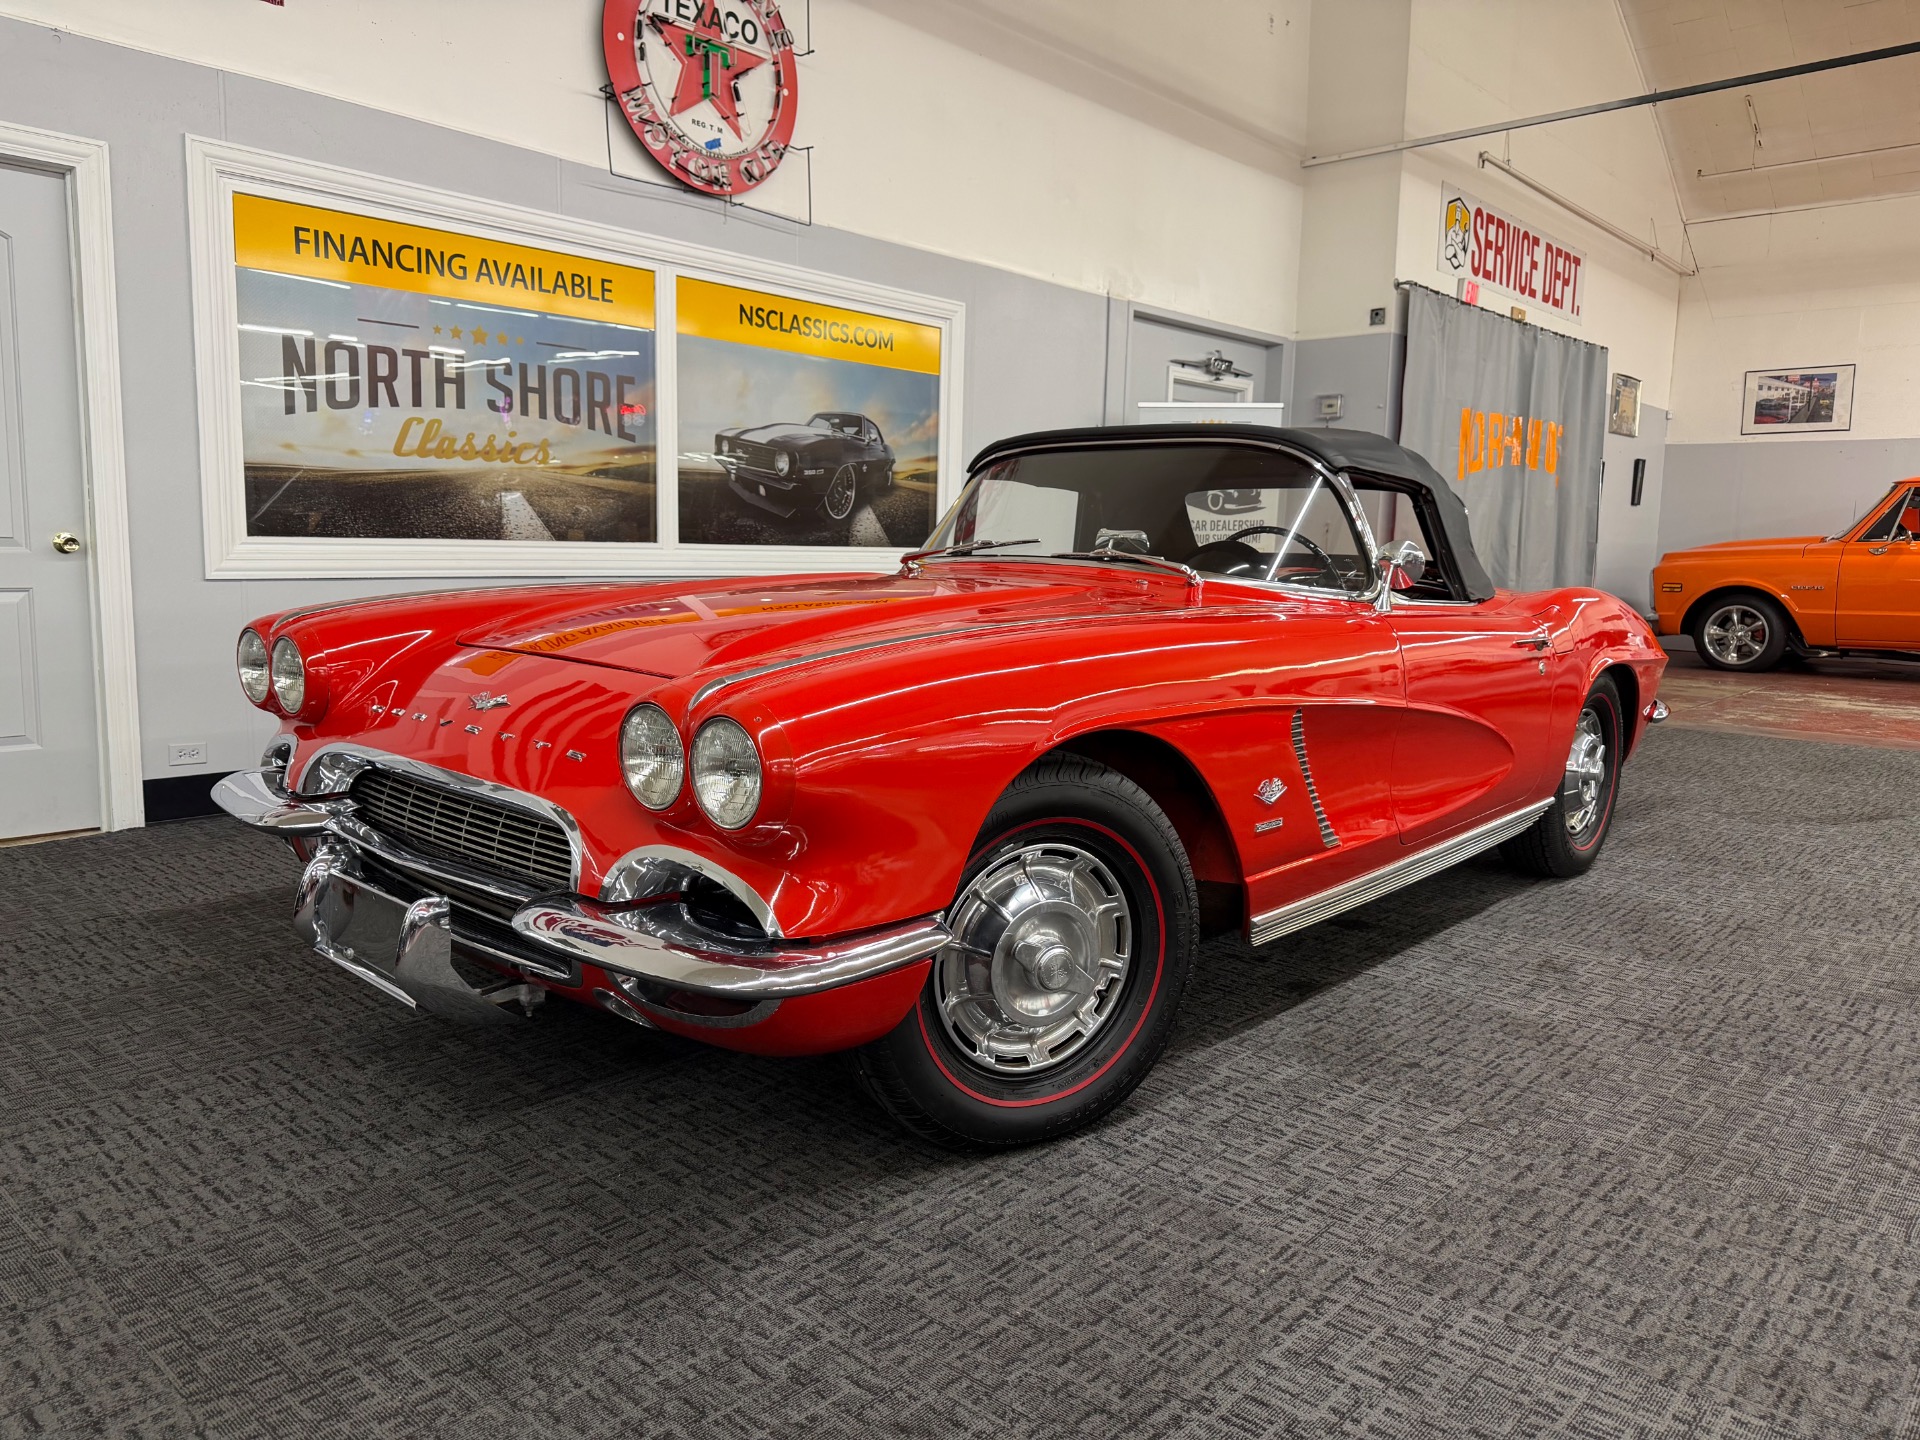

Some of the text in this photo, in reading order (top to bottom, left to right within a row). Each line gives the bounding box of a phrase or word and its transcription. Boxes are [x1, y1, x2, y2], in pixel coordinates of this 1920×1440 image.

[293, 225, 614, 304] FINANCING AVAILABLE
[1471, 206, 1582, 317] SERVICE DEPT.
[739, 303, 894, 352] NSCLASSICS.COM
[282, 334, 639, 444] NORTH SHORE
[392, 416, 553, 466] Classics
